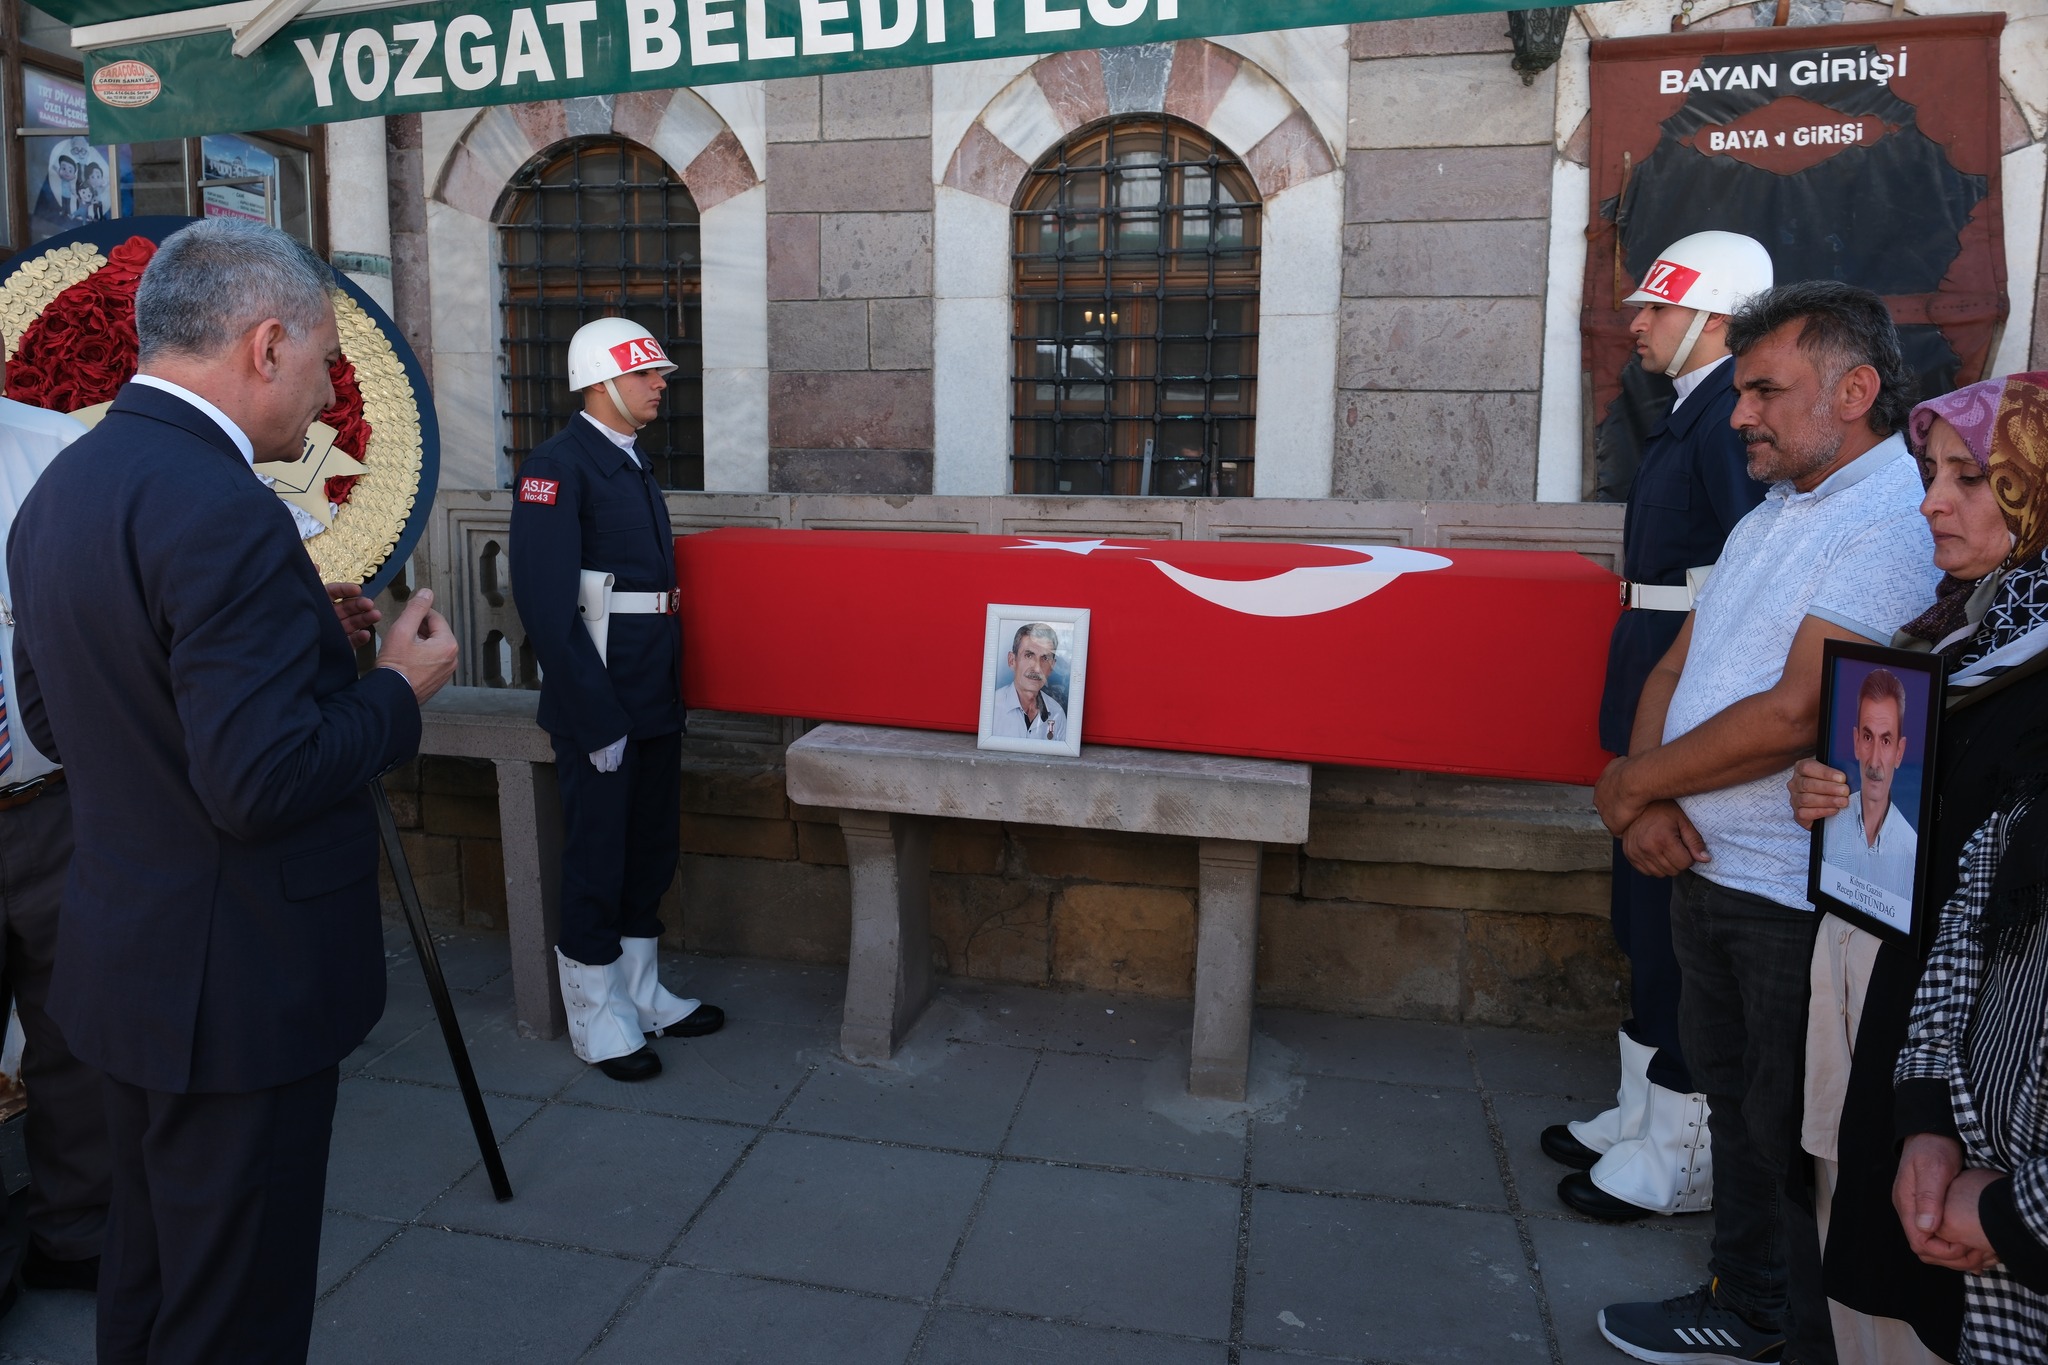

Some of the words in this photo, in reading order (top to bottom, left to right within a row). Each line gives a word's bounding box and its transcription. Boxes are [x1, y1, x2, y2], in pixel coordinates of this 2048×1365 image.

[294, 1, 597, 107] YOZGAT
[625, 0, 1178, 72] BELEDY
[1660, 63, 1777, 94] BAYAN
[54, 88, 87, 110] DİYANE
[1836, 881, 1854, 900] Recep
[1854, 888, 1896, 918] ÜSTÜNDAĞ
